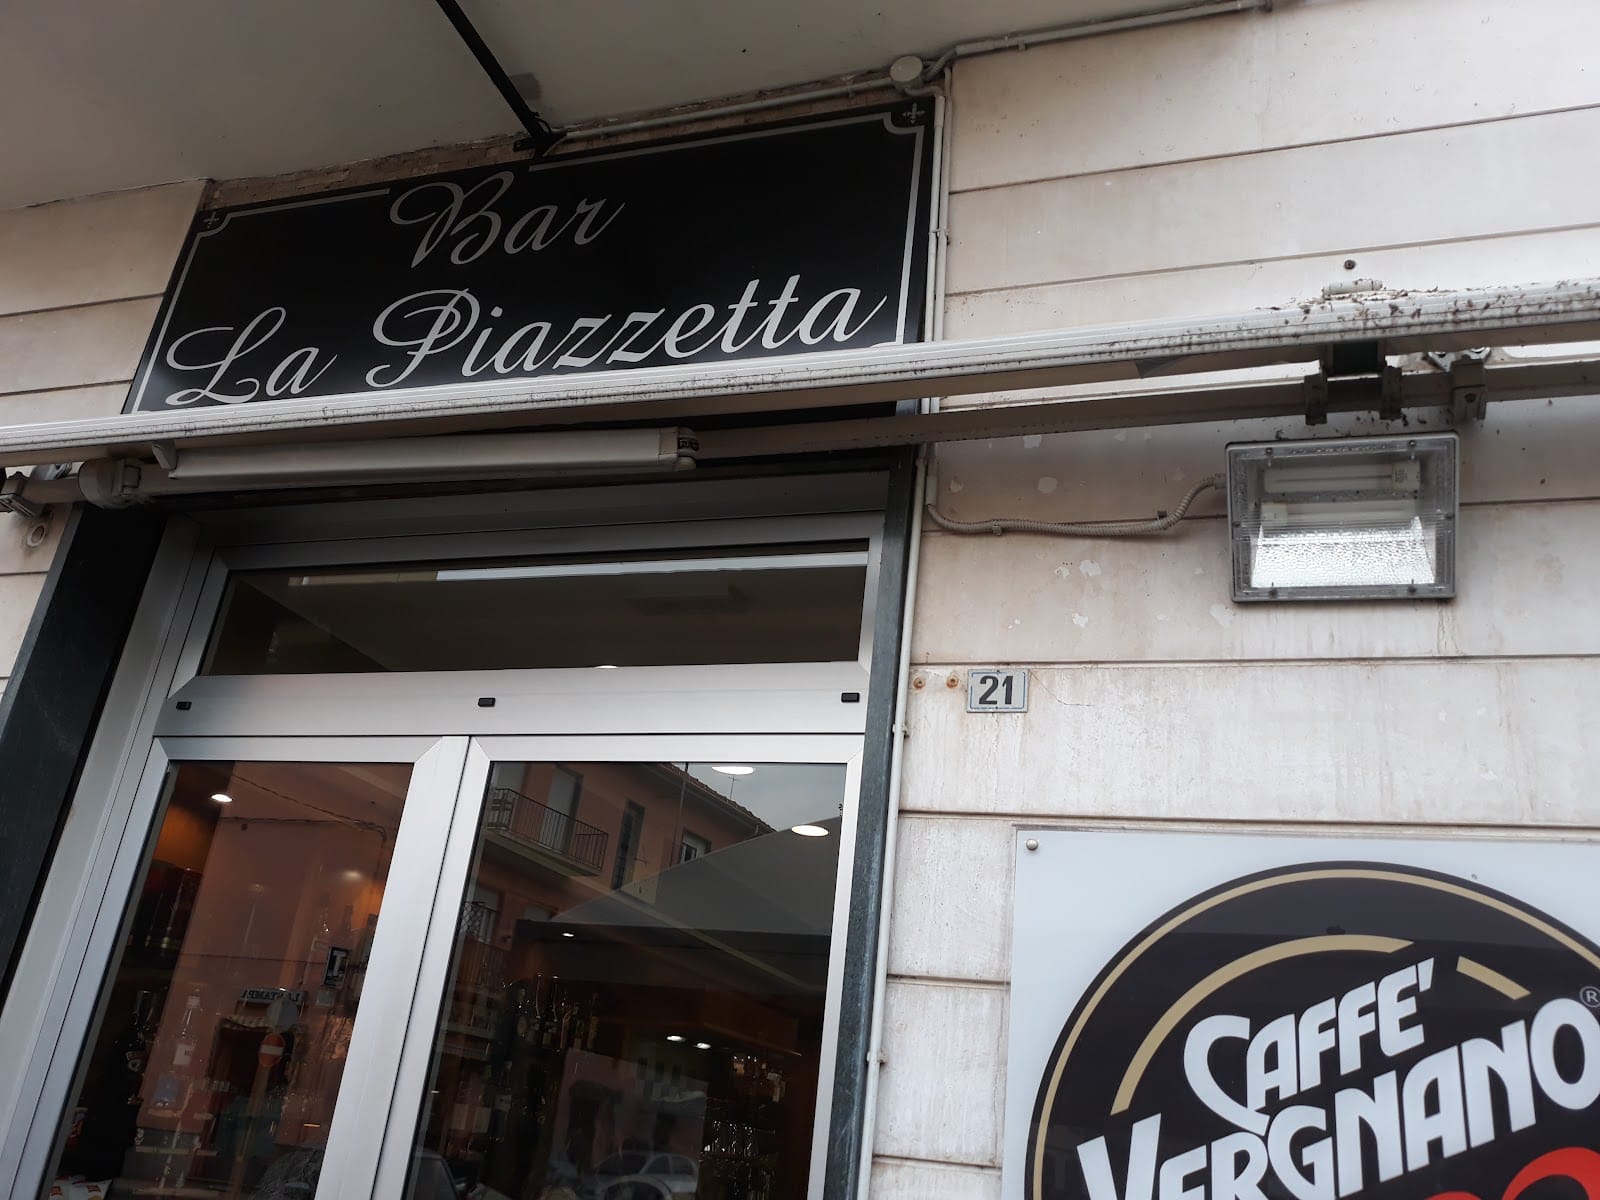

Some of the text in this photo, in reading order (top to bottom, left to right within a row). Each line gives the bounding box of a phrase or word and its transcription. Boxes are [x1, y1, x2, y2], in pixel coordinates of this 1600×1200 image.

[389, 171, 624, 268] Bar
[165, 274, 886, 405] La Piazzetta
[978, 675, 1014, 704] 21
